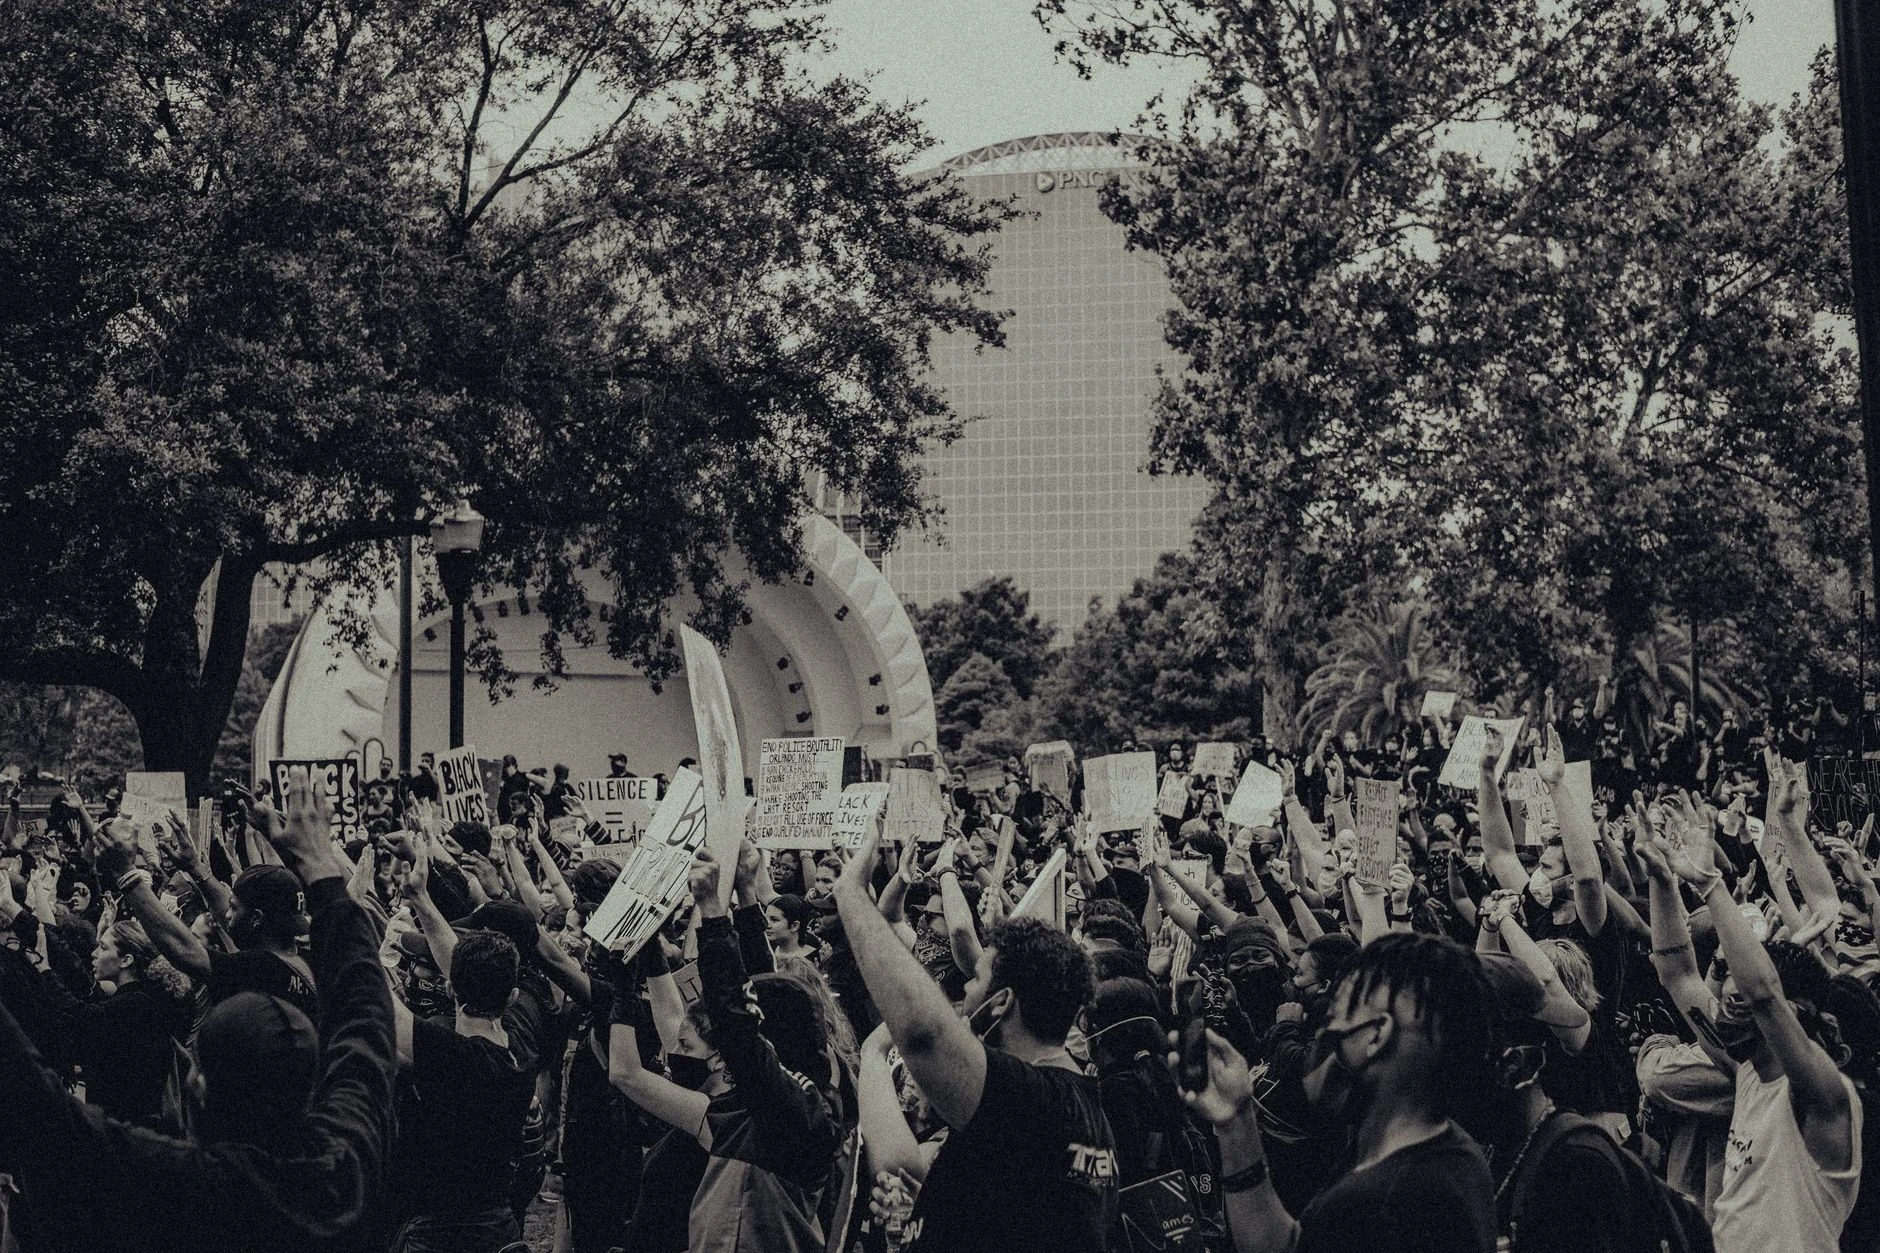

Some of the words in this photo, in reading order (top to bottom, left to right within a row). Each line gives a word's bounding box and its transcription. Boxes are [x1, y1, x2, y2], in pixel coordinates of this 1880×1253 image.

[762, 741, 777, 753] END
[799, 752, 818, 764] MUST
[439, 751, 482, 796] BLACK
[578, 780, 648, 801] SILENCE
[801, 780, 829, 791] SHOOTING
[784, 791, 810, 802] SHOOTING
[811, 790, 822, 801] THE
[763, 804, 780, 815] LAST
[782, 801, 809, 813] RESORT
[784, 813, 797, 825] ALL
[797, 813, 808, 825] USE
[815, 812, 834, 825] FORCE
[762, 827, 773, 838] END
